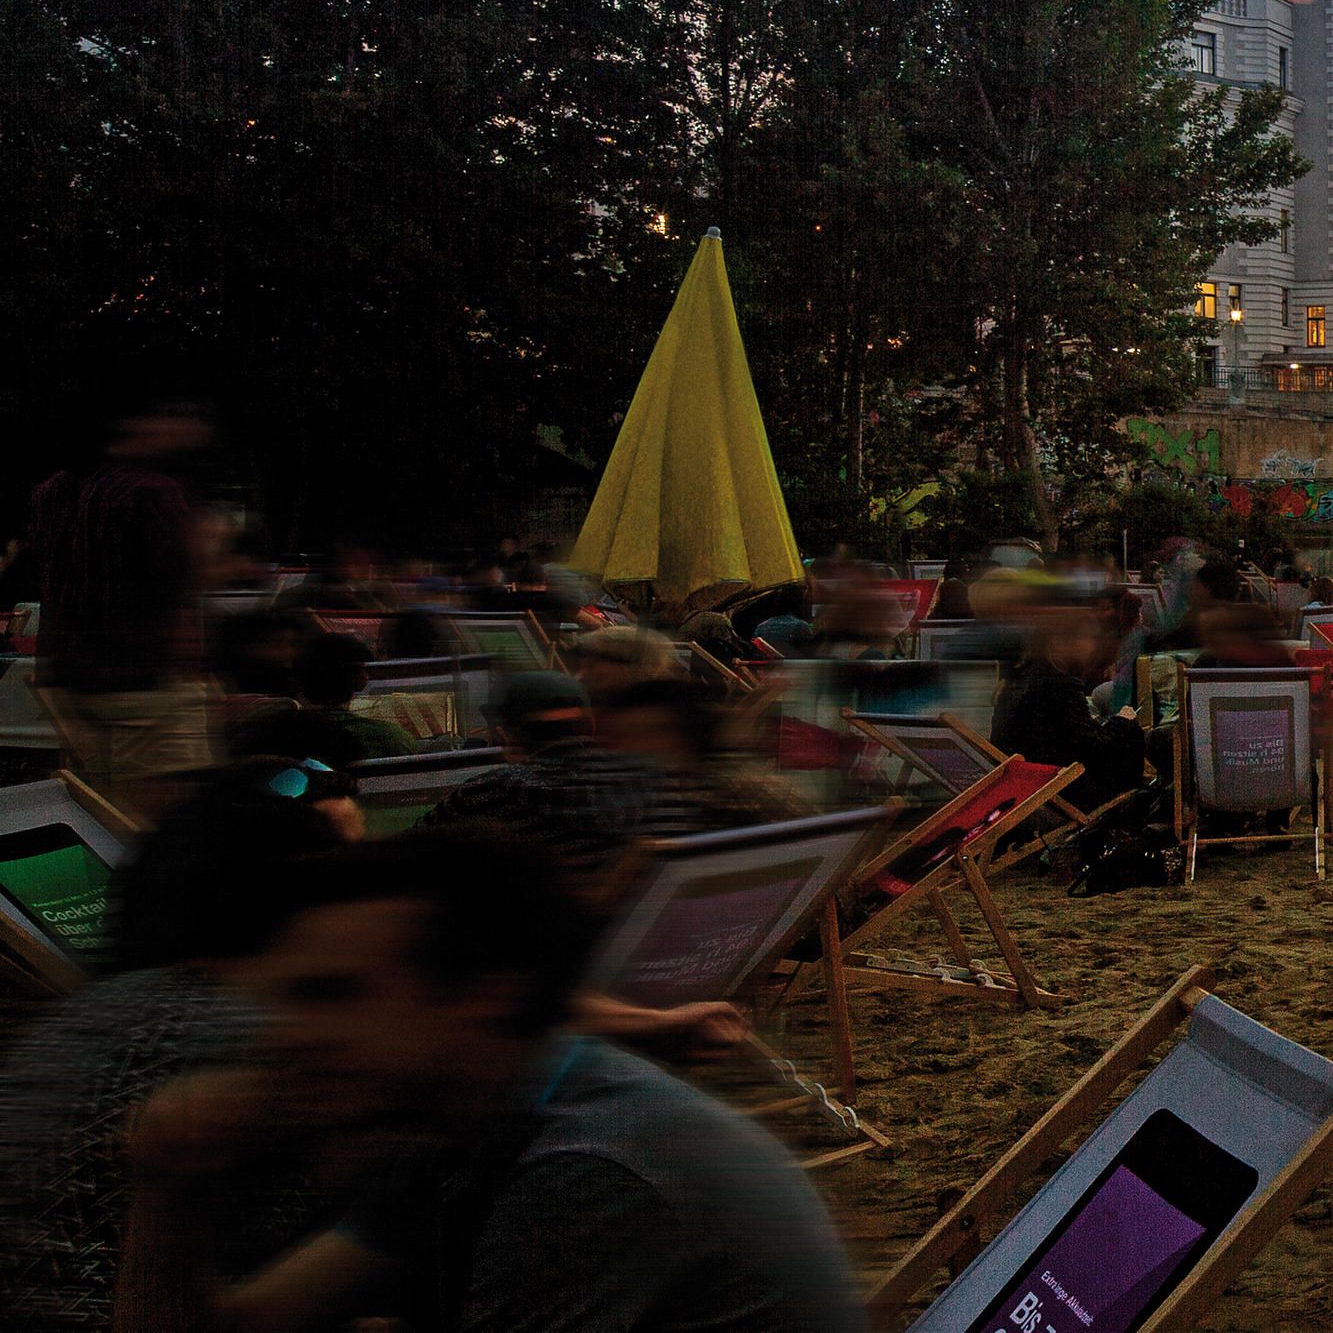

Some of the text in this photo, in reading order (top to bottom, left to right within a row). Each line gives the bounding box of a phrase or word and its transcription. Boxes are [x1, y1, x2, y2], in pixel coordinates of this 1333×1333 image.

[42, 897, 108, 923] Cocktail
[55, 923, 94, 936] über
[1009, 1291, 1043, 1333] Bis
